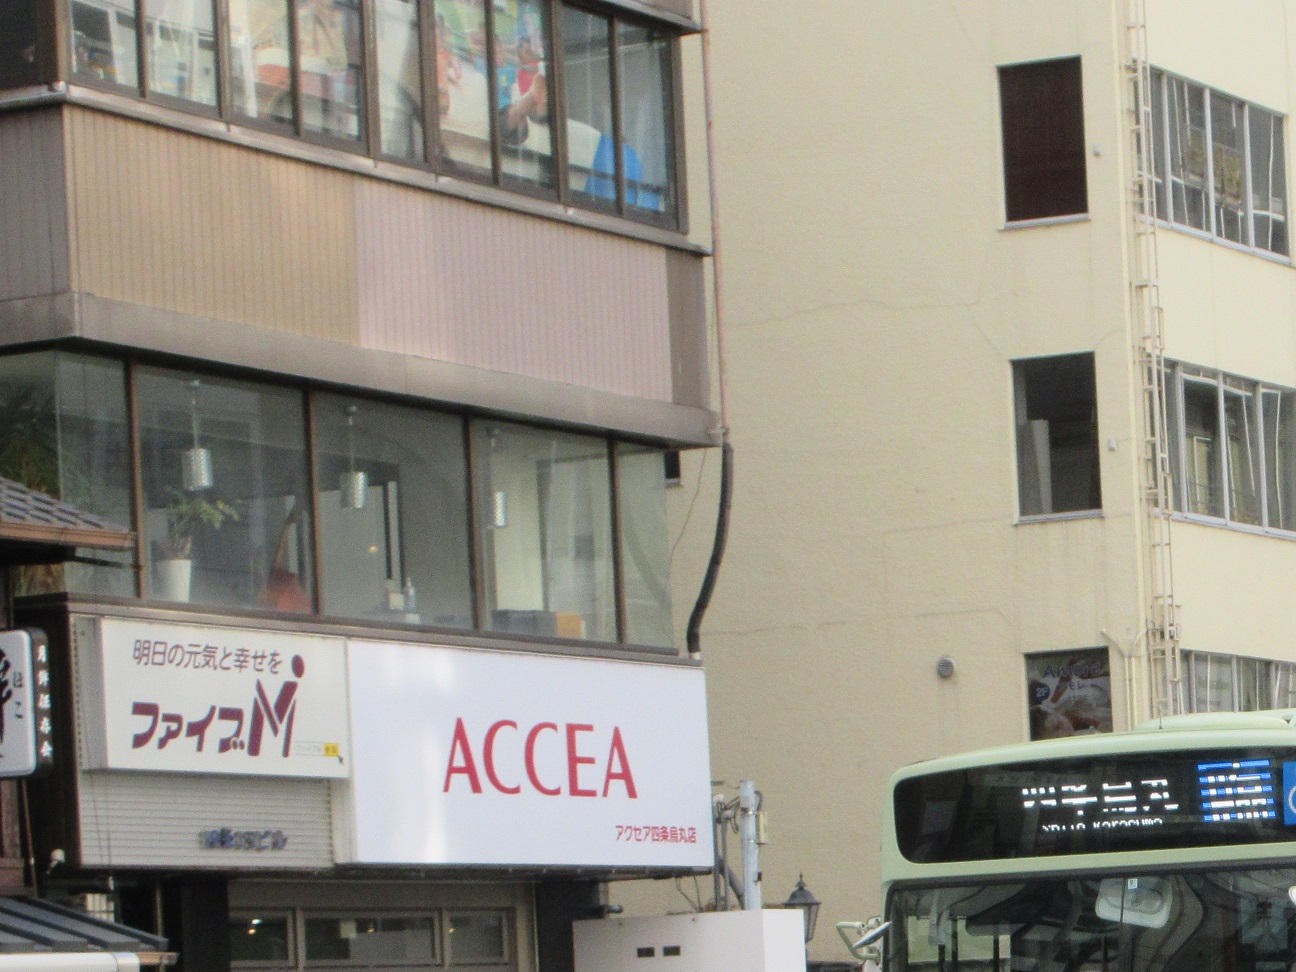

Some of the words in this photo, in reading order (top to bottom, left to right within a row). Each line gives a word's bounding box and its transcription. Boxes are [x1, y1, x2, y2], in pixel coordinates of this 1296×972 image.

[133, 639, 284, 674] 明日の元気と幸せを
[443, 717, 638, 799] ACCEA
[615, 825, 697, 843] アクセア四条烏丸店
